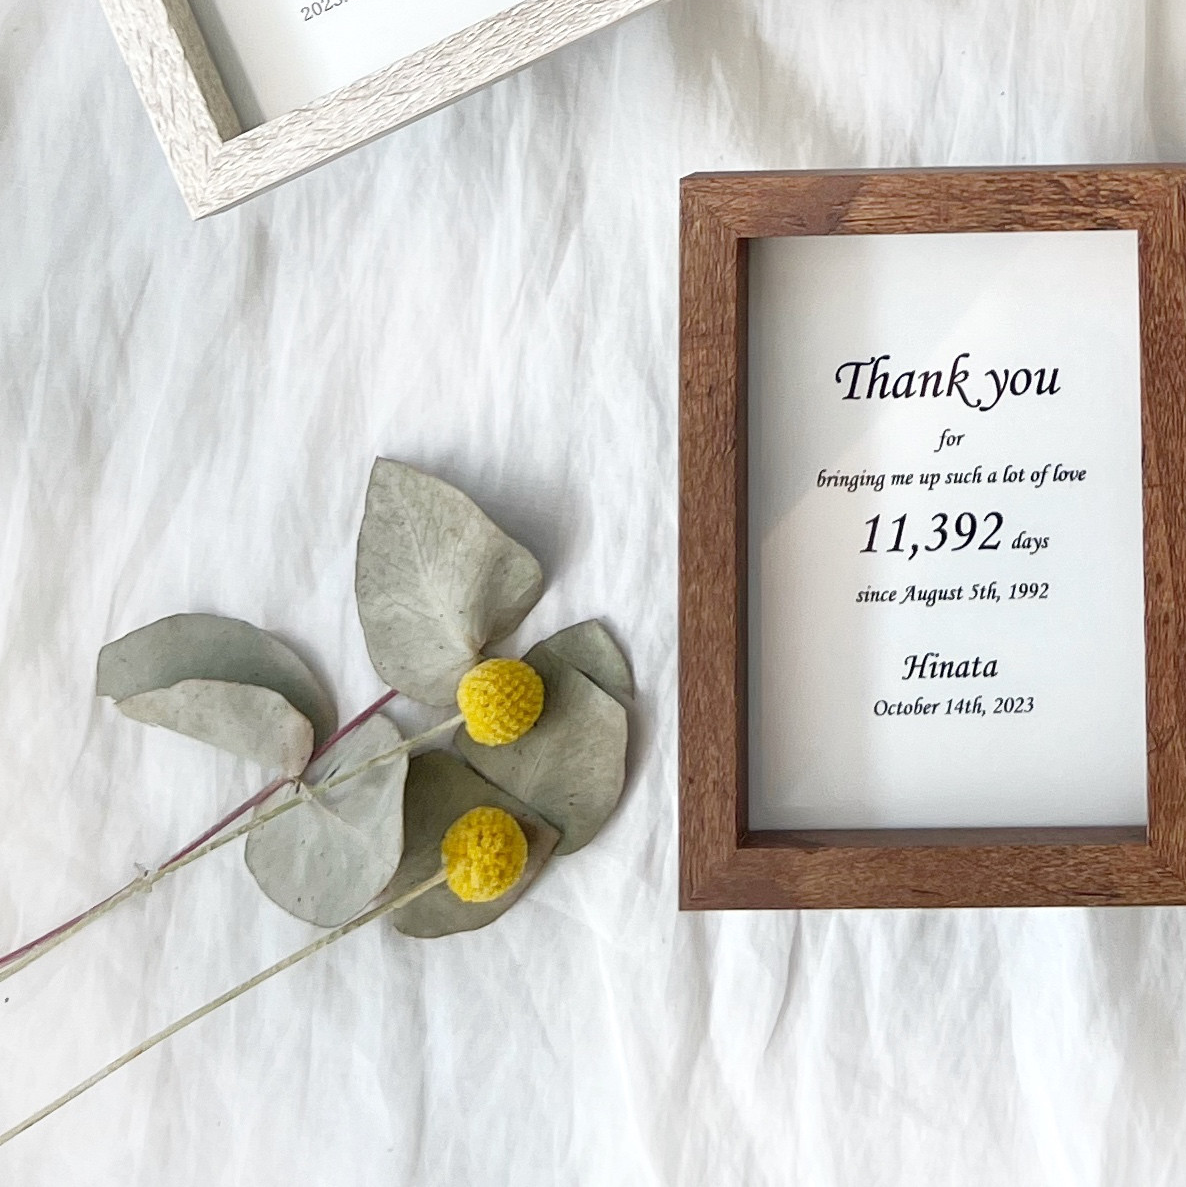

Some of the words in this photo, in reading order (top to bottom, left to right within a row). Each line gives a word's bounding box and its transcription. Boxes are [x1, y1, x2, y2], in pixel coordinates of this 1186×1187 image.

[835, 352, 982, 409] Thank
[978, 365, 1061, 413] you
[934, 429, 965, 453] for
[817, 469, 885, 492] bringing
[890, 473, 914, 487] me
[919, 472, 941, 491] up
[945, 467, 982, 486] such
[987, 471, 997, 484] a
[1002, 466, 1025, 484] lot
[1030, 464, 1051, 489] of
[1052, 466, 1087, 483] love
[859, 511, 1005, 561] 11,392
[1011, 532, 1050, 554] days
[855, 584, 897, 604] since
[899, 584, 963, 607] August
[969, 583, 1001, 603] 5th,
[1008, 582, 1049, 601] 1992
[902, 652, 999, 681] Hinata
[873, 696, 940, 717] October
[945, 696, 986, 717] 14th,
[993, 696, 1035, 715] 2023
